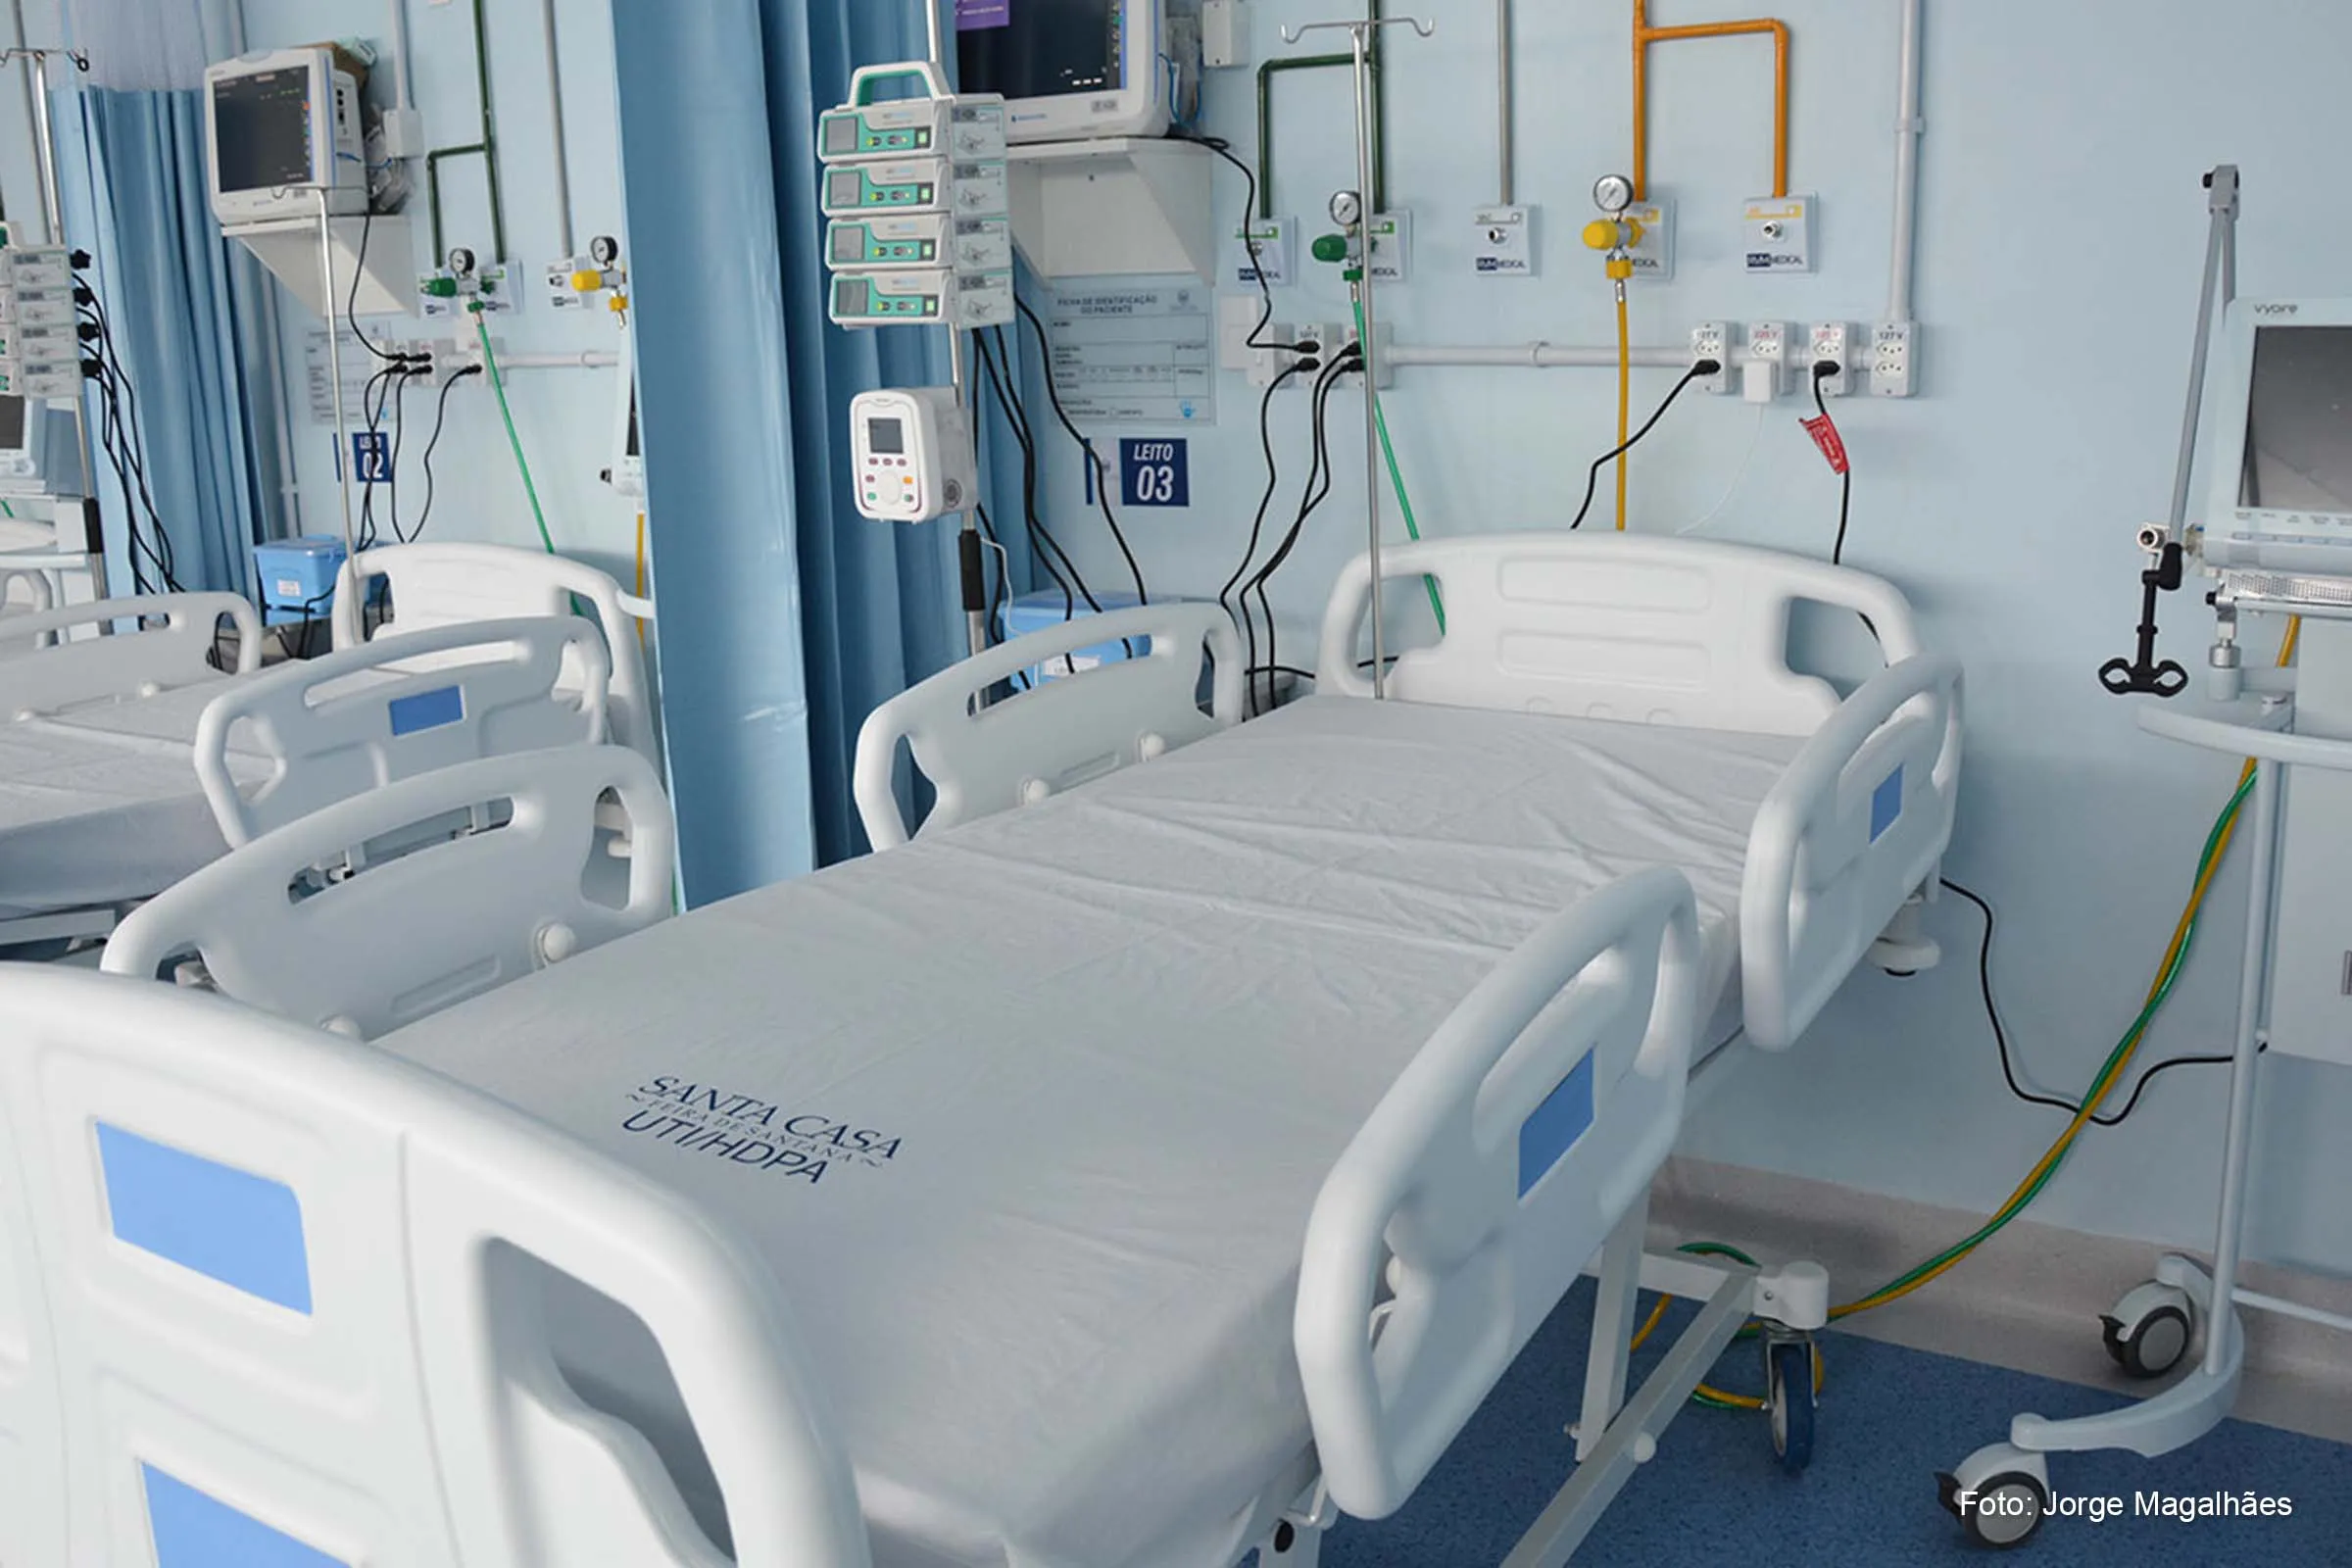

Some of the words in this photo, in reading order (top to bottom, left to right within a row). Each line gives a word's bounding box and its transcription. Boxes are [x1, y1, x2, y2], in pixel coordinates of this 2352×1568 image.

[363, 452, 384, 479] 02
[1133, 443, 1174, 462] LEITO
[1137, 466, 1174, 501] 03
[639, 1076, 778, 1126] SANTA
[784, 1115, 903, 1159] CASA
[647, 1100, 709, 1123] FEIRA
[713, 1119, 739, 1132] DE
[744, 1126, 852, 1163] SANTANA
[622, 1109, 829, 1184] UTI/HDPA
